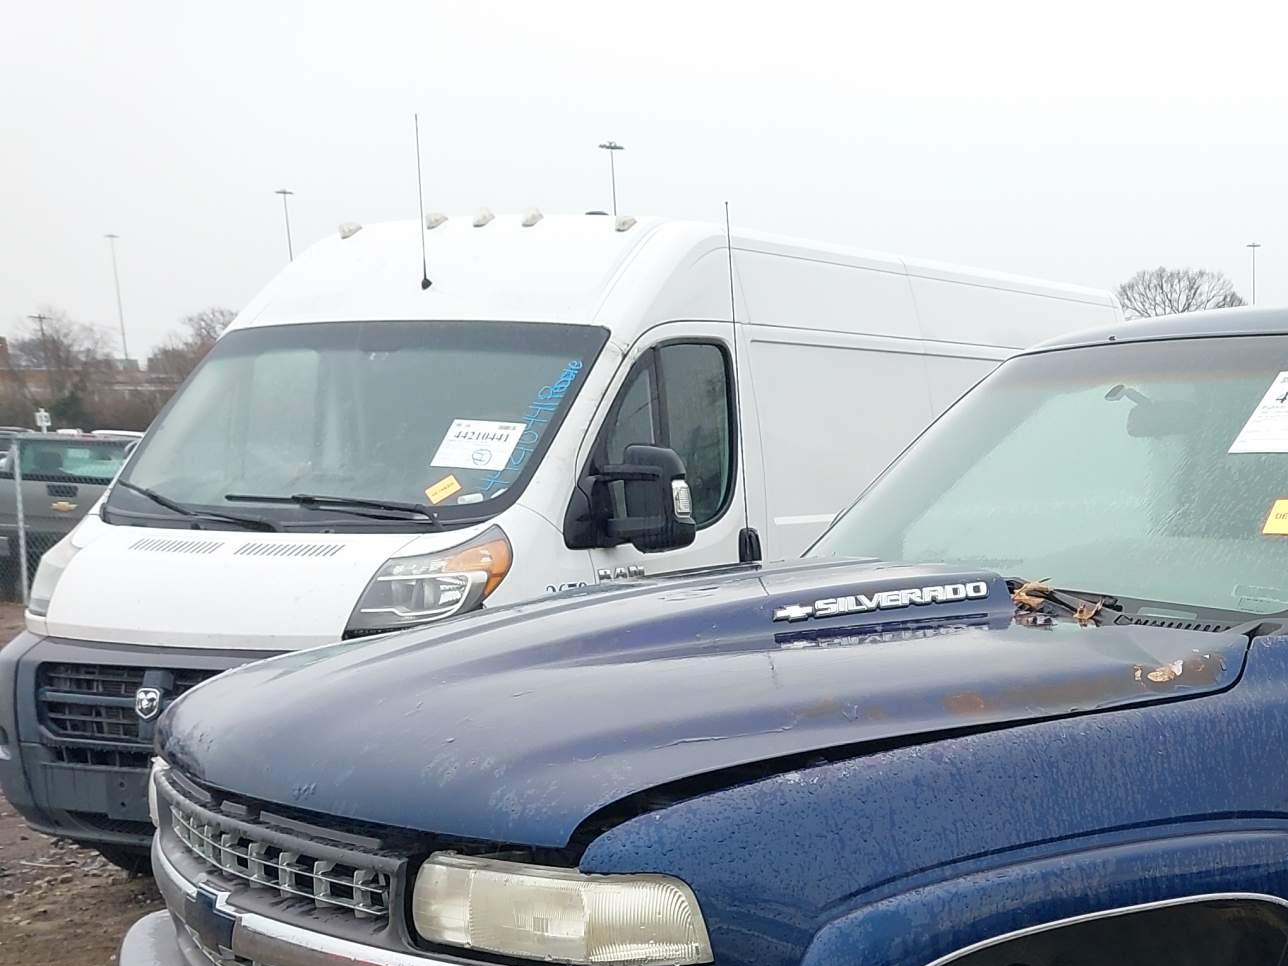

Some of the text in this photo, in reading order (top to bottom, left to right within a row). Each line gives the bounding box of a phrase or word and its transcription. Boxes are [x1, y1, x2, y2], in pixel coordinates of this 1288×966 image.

[453, 430, 510, 442] 44210441
[597, 565, 646, 581] RAM
[814, 581, 990, 618] SILVERADO
